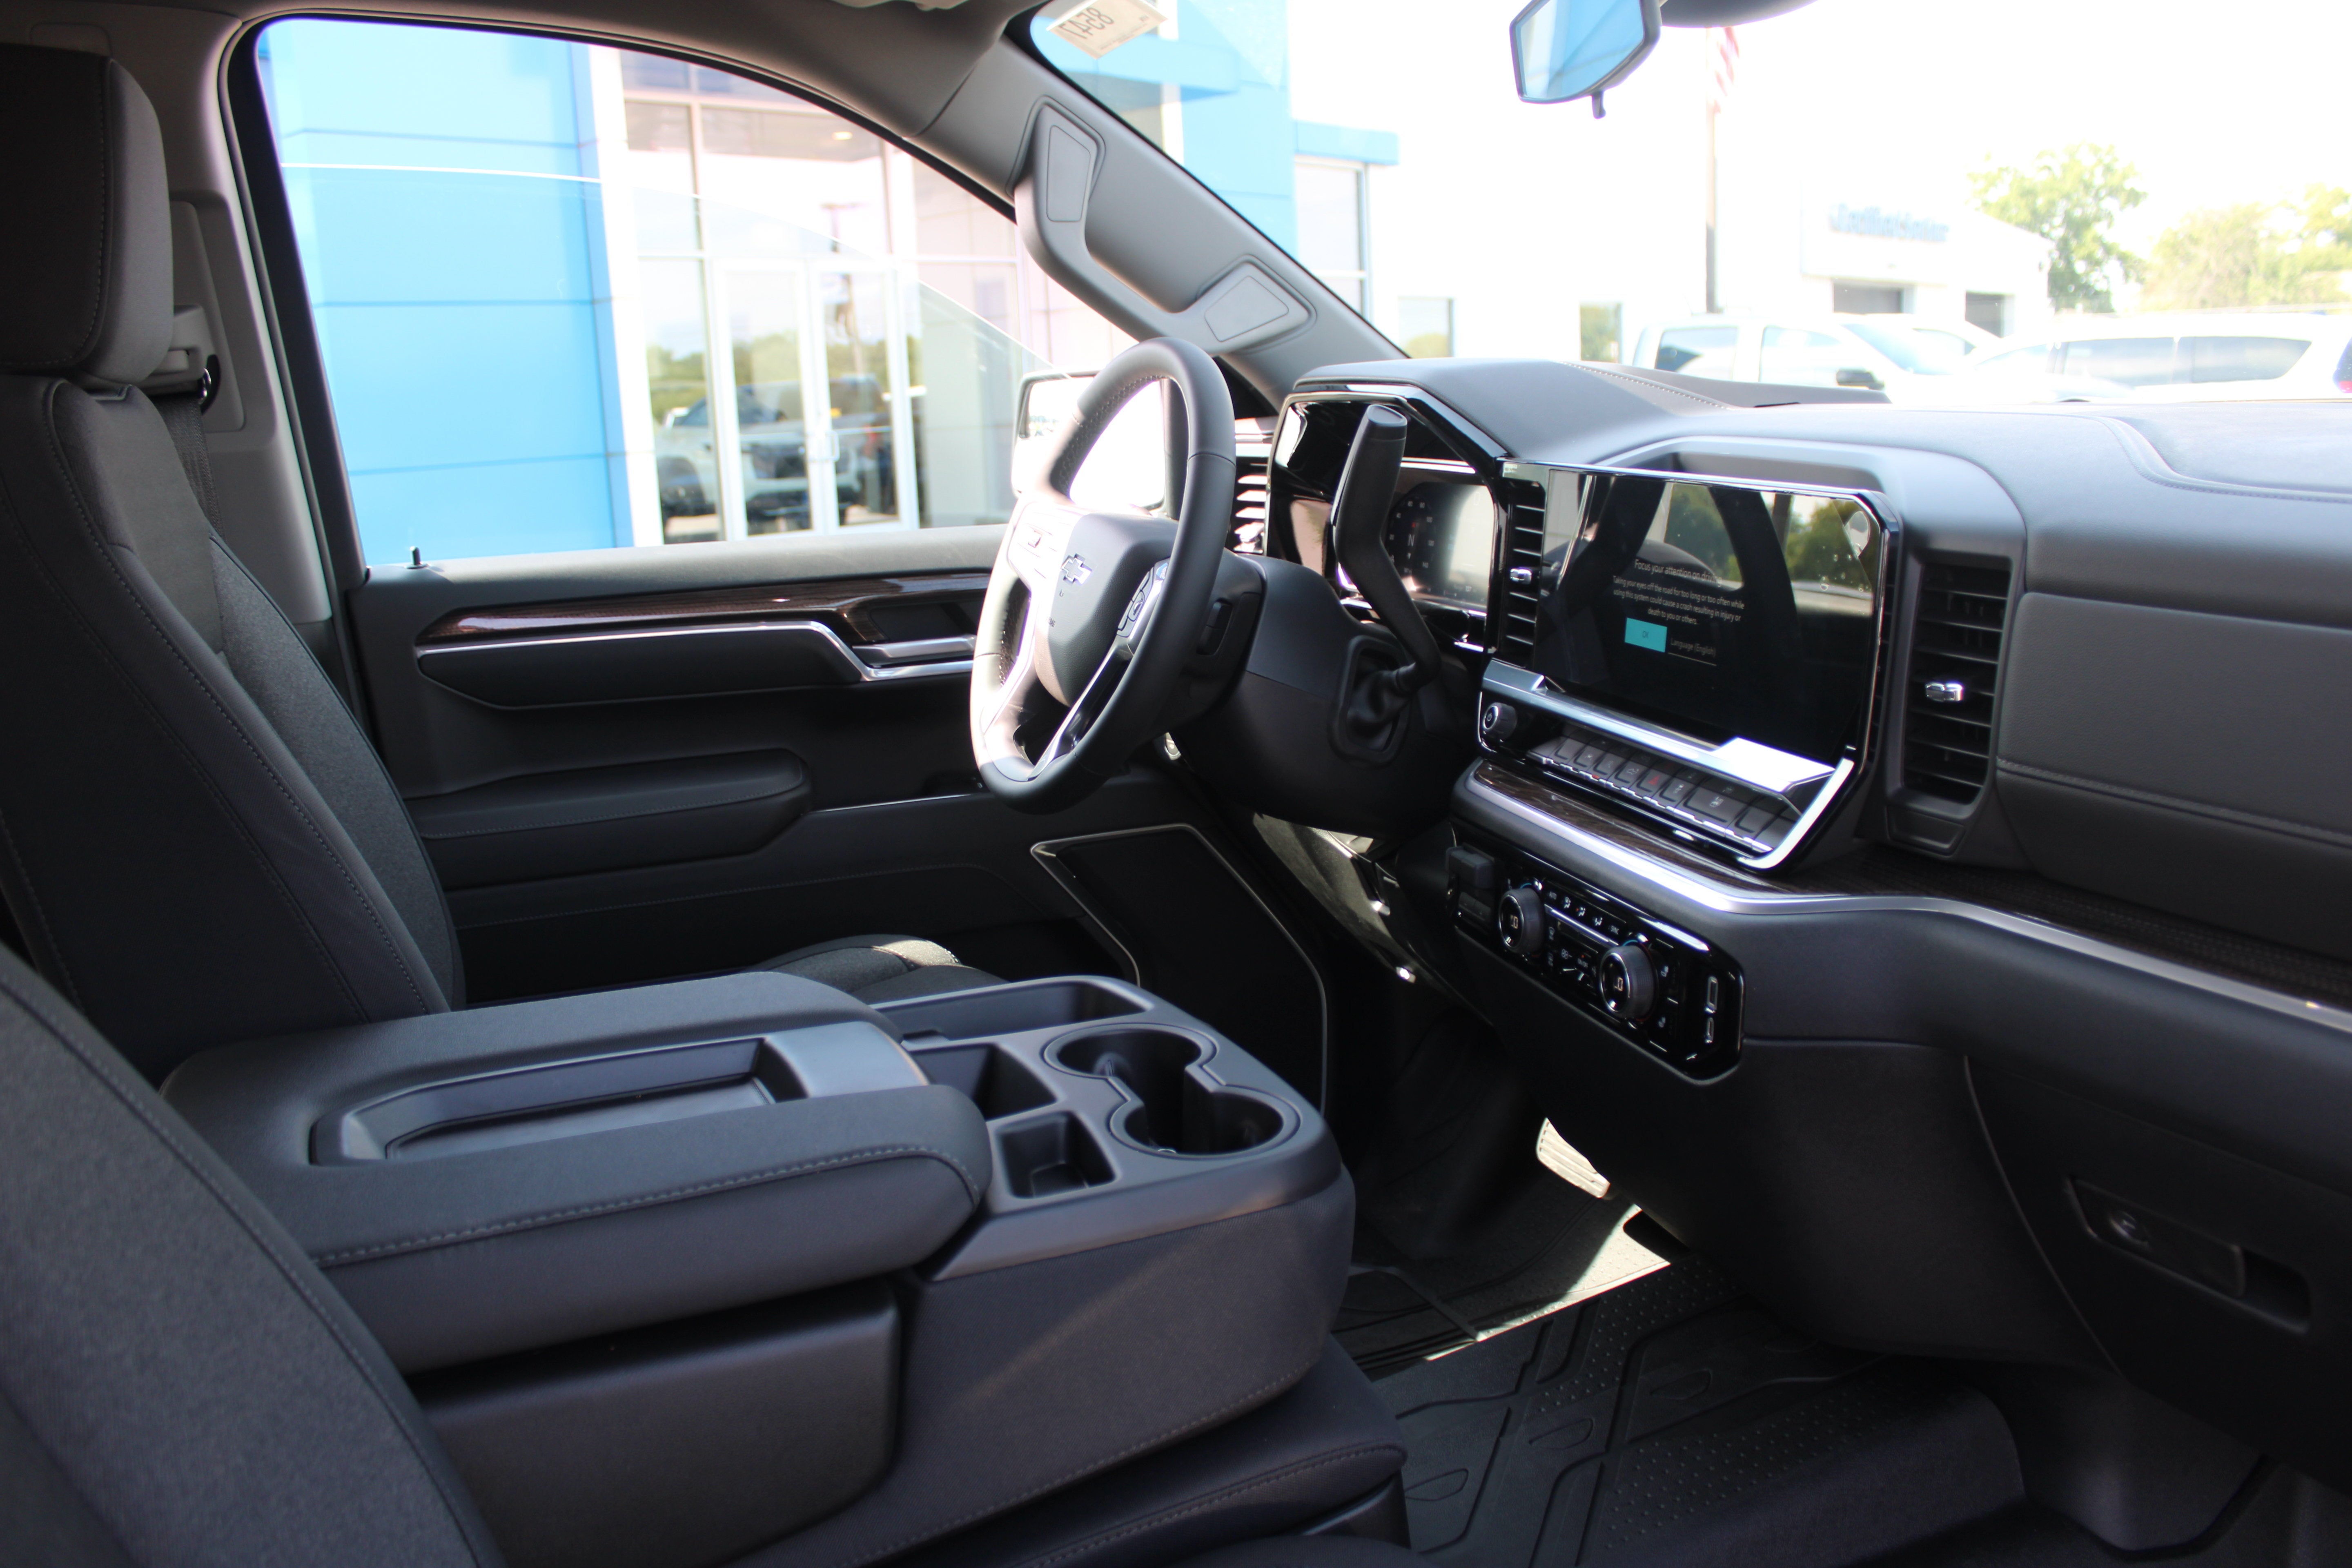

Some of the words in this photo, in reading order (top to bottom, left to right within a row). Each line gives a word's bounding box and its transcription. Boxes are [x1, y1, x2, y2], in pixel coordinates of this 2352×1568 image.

[1408, 534, 1414, 546] N
[1635, 559, 1651, 571] Focus
[1651, 565, 1664, 575] your
[1664, 566, 1691, 578] attention
[1702, 571, 1722, 587] driving
[1613, 575, 1627, 587] Taking
[1637, 582, 1647, 590] eyes
[1690, 591, 1701, 602] long
[1717, 597, 1730, 606] often
[1731, 599, 1744, 609] while
[1613, 589, 1625, 599] using
[1625, 590, 1633, 598] this
[1650, 596, 1662, 604] could
[1680, 603, 1693, 611] crash
[1693, 606, 1714, 618] resulting
[1720, 610, 1734, 622] injury
[1648, 607, 1661, 616] death
[1670, 638, 1693, 652] Language
[1695, 643, 1717, 657] (English)
